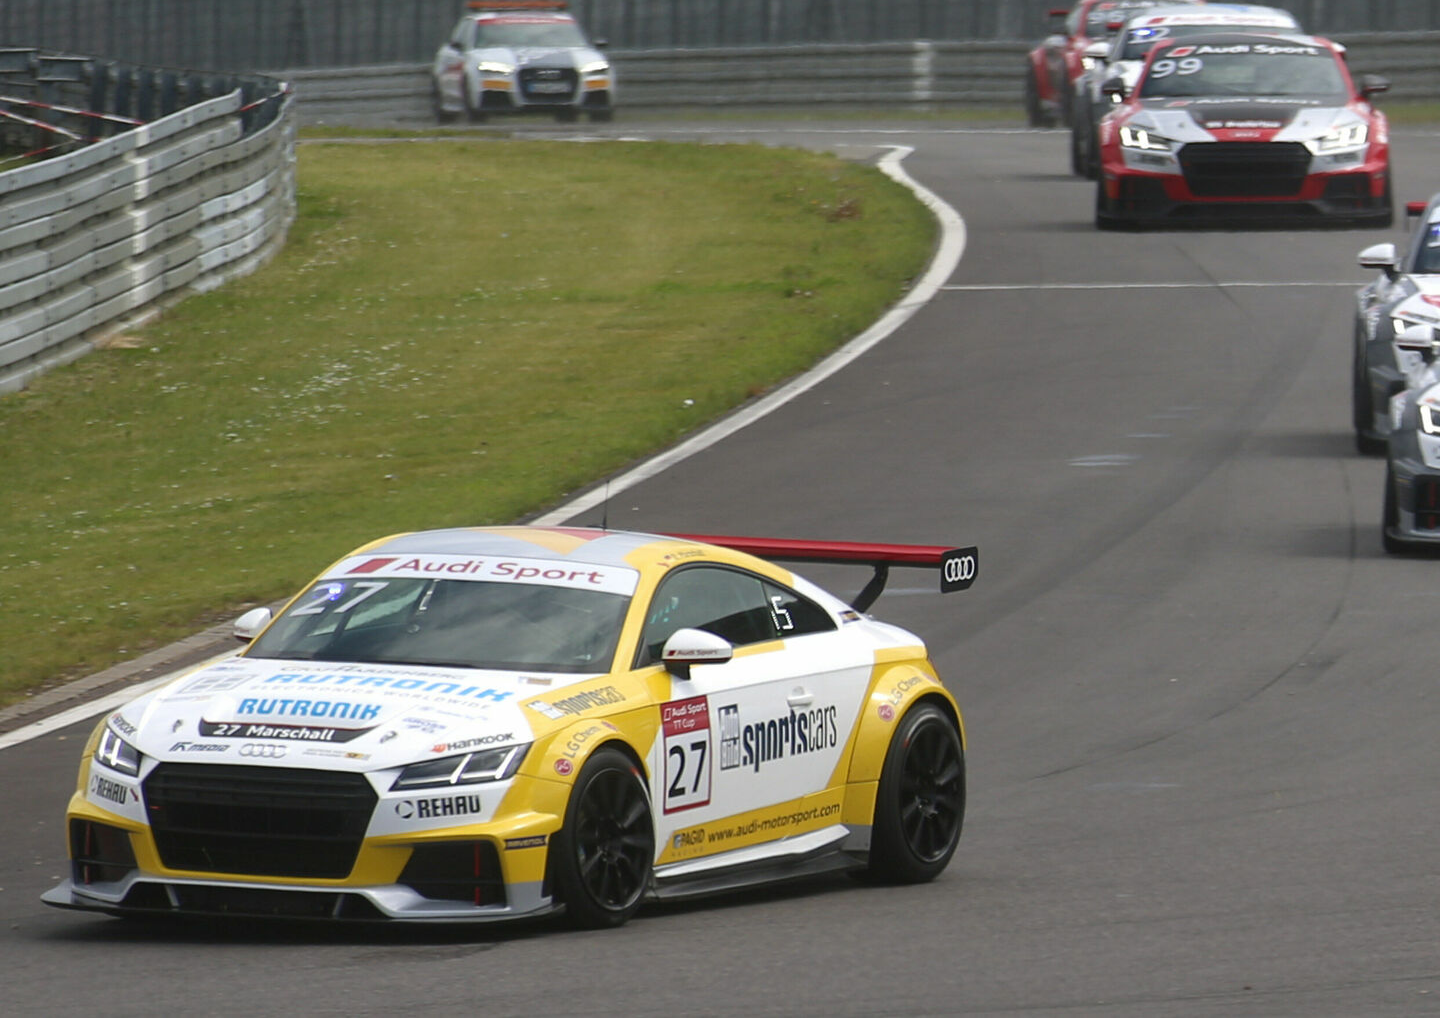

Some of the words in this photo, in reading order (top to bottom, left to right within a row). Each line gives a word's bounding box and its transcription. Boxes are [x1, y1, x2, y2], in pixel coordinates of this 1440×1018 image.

[1196, 45, 1250, 55] Audi
[1254, 44, 1319, 56] Sport
[1150, 58, 1204, 78] 99
[392, 558, 484, 574] Audi
[490, 561, 607, 585] Sport
[288, 582, 390, 617] 27
[263, 673, 515, 703] RUTRONIK
[237, 698, 382, 721] RUTRONIK
[672, 707, 687, 718] Audi
[687, 702, 707, 715] Sport
[212, 724, 242, 736] 27
[246, 725, 336, 741] Marschall
[673, 719, 682, 730] TT
[683, 718, 695, 729] Cup
[742, 705, 837, 773] sportscars
[668, 740, 707, 799] 27
[97, 777, 128, 805] REHAU
[418, 794, 482, 819] REHAU
[708, 802, 841, 843] www.audi-motorsport.com
[680, 828, 706, 847] PAGID
